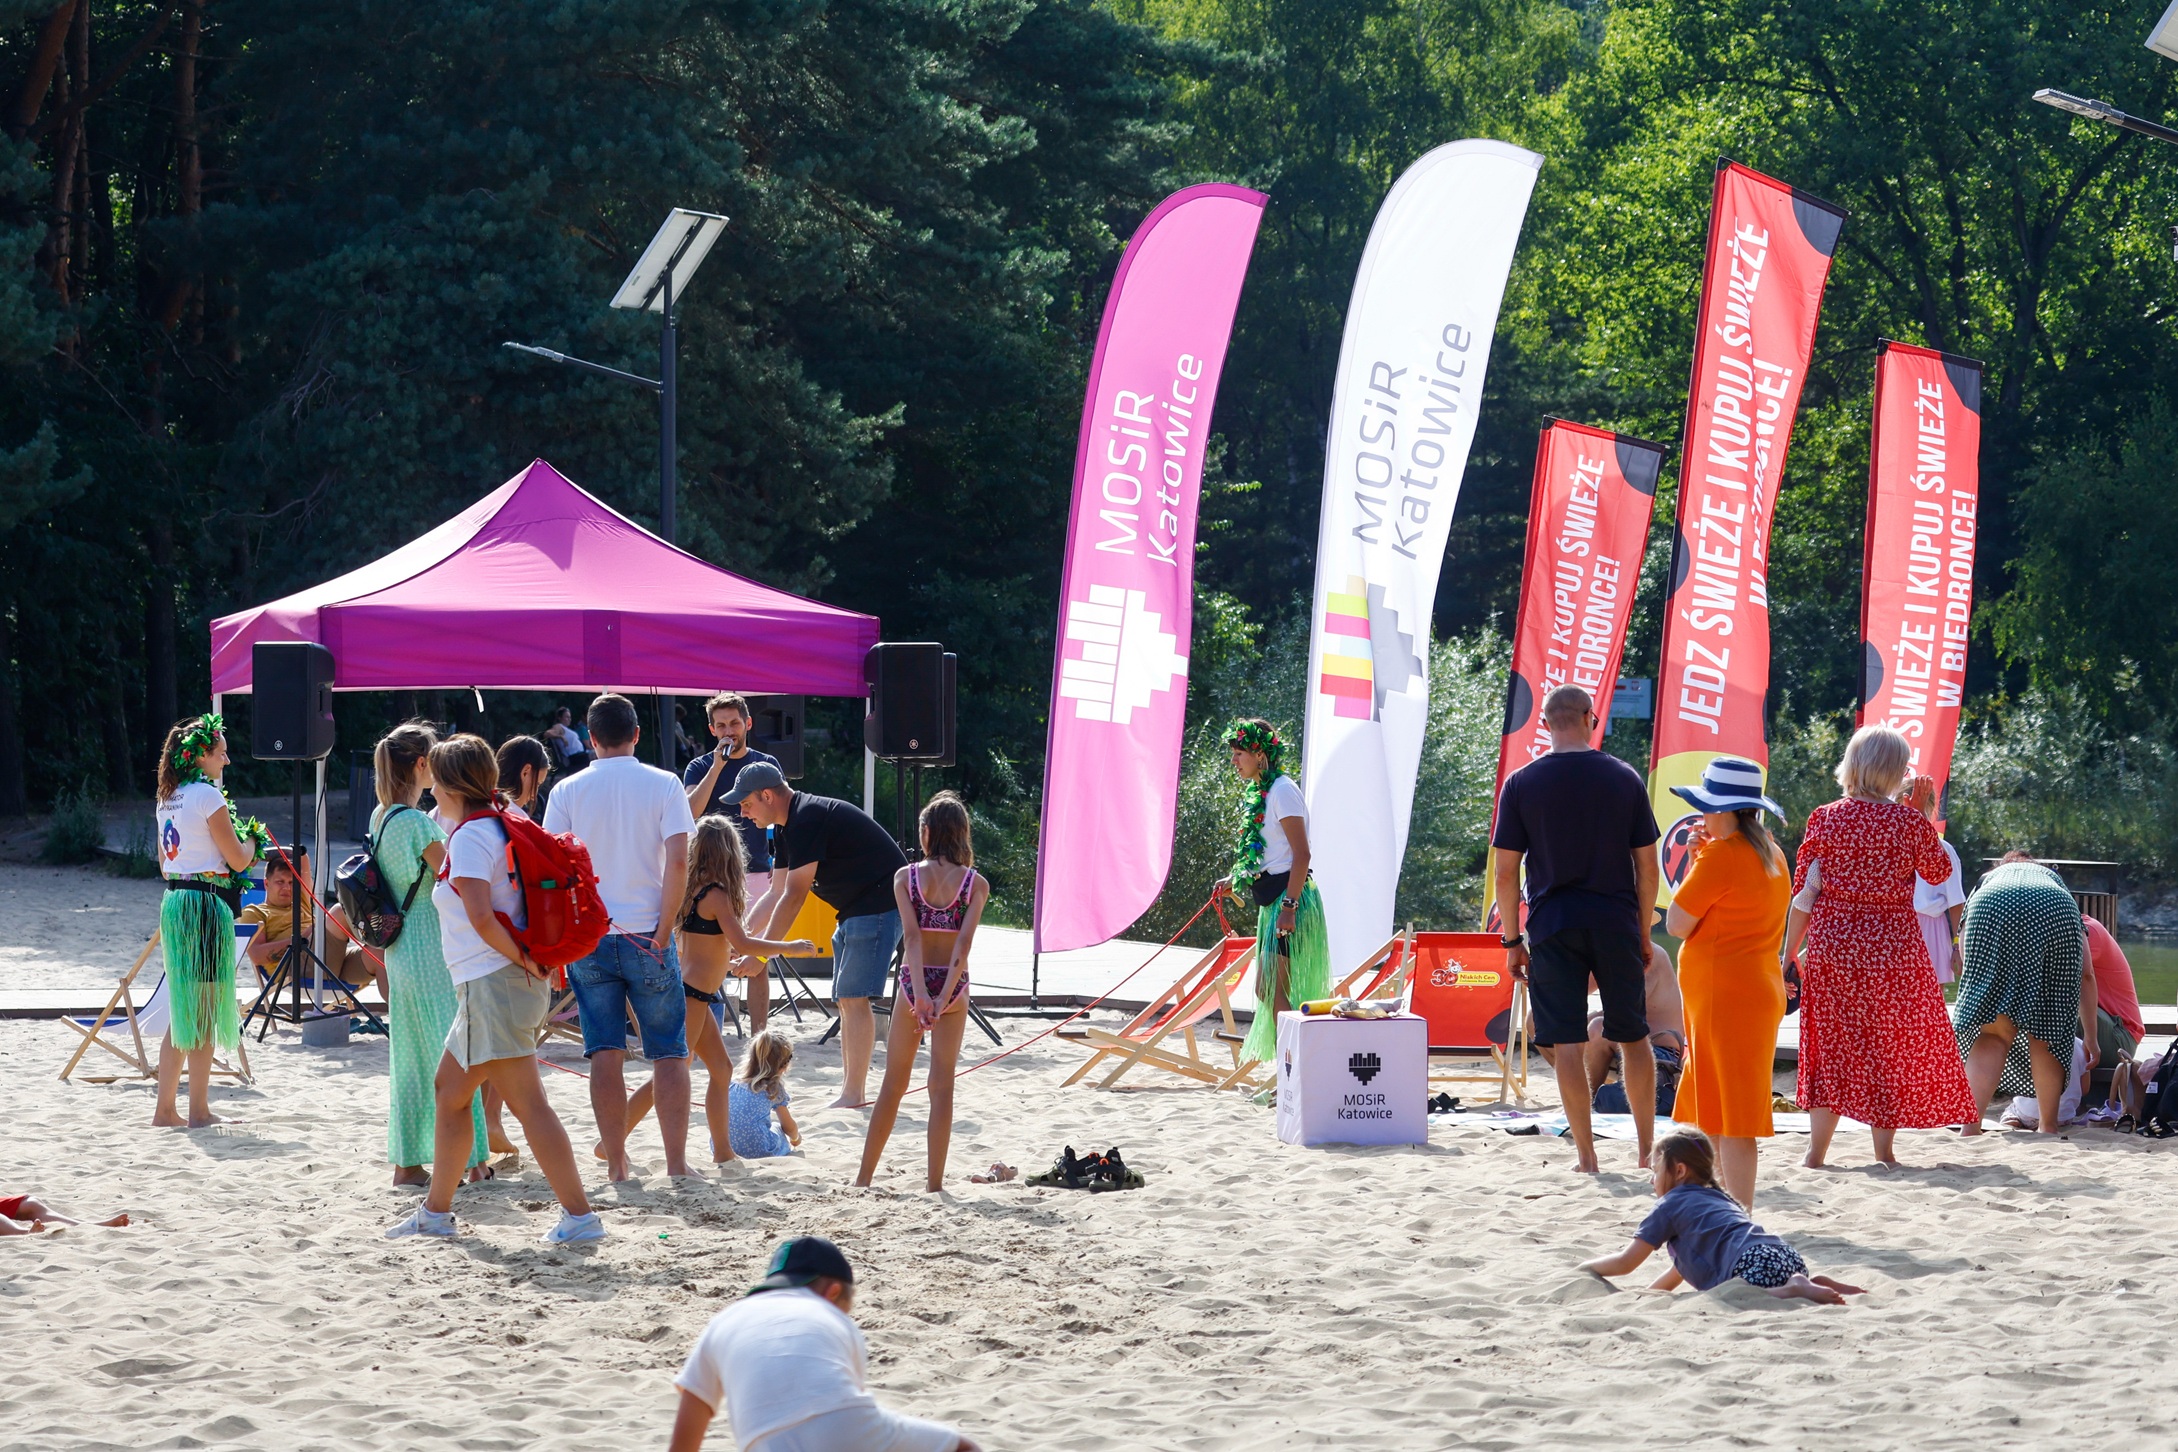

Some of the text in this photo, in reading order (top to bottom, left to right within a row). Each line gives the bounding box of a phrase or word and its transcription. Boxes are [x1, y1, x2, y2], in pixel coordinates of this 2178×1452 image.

[1094, 389, 1155, 556] MOSiR
[1146, 353, 1204, 567] Katowice
[1351, 360, 1407, 545] MOSiR
[1392, 323, 1472, 561] Katowice
[1707, 355, 1754, 472] KUPUJ
[1910, 378, 1947, 494] ŚWIEŻE
[1705, 474, 1747, 492] I
[1526, 454, 1605, 760] ŚWŻE I KUPUJ ŚWIEŻE
[1681, 494, 1746, 637] ŚWIEŻE
[1906, 500, 1944, 597] KUPUJ
[1936, 489, 1978, 708] W BIEDRONCE!
[1573, 554, 1621, 709] EDRONCE!
[1904, 603, 1938, 615] I
[1679, 640, 1729, 734] JEDZ
[1881, 620, 1936, 738] ŚWIEŻE
[1338, 1107, 1393, 1119] Katowice
[1344, 1094, 1386, 1106] MOSiR
